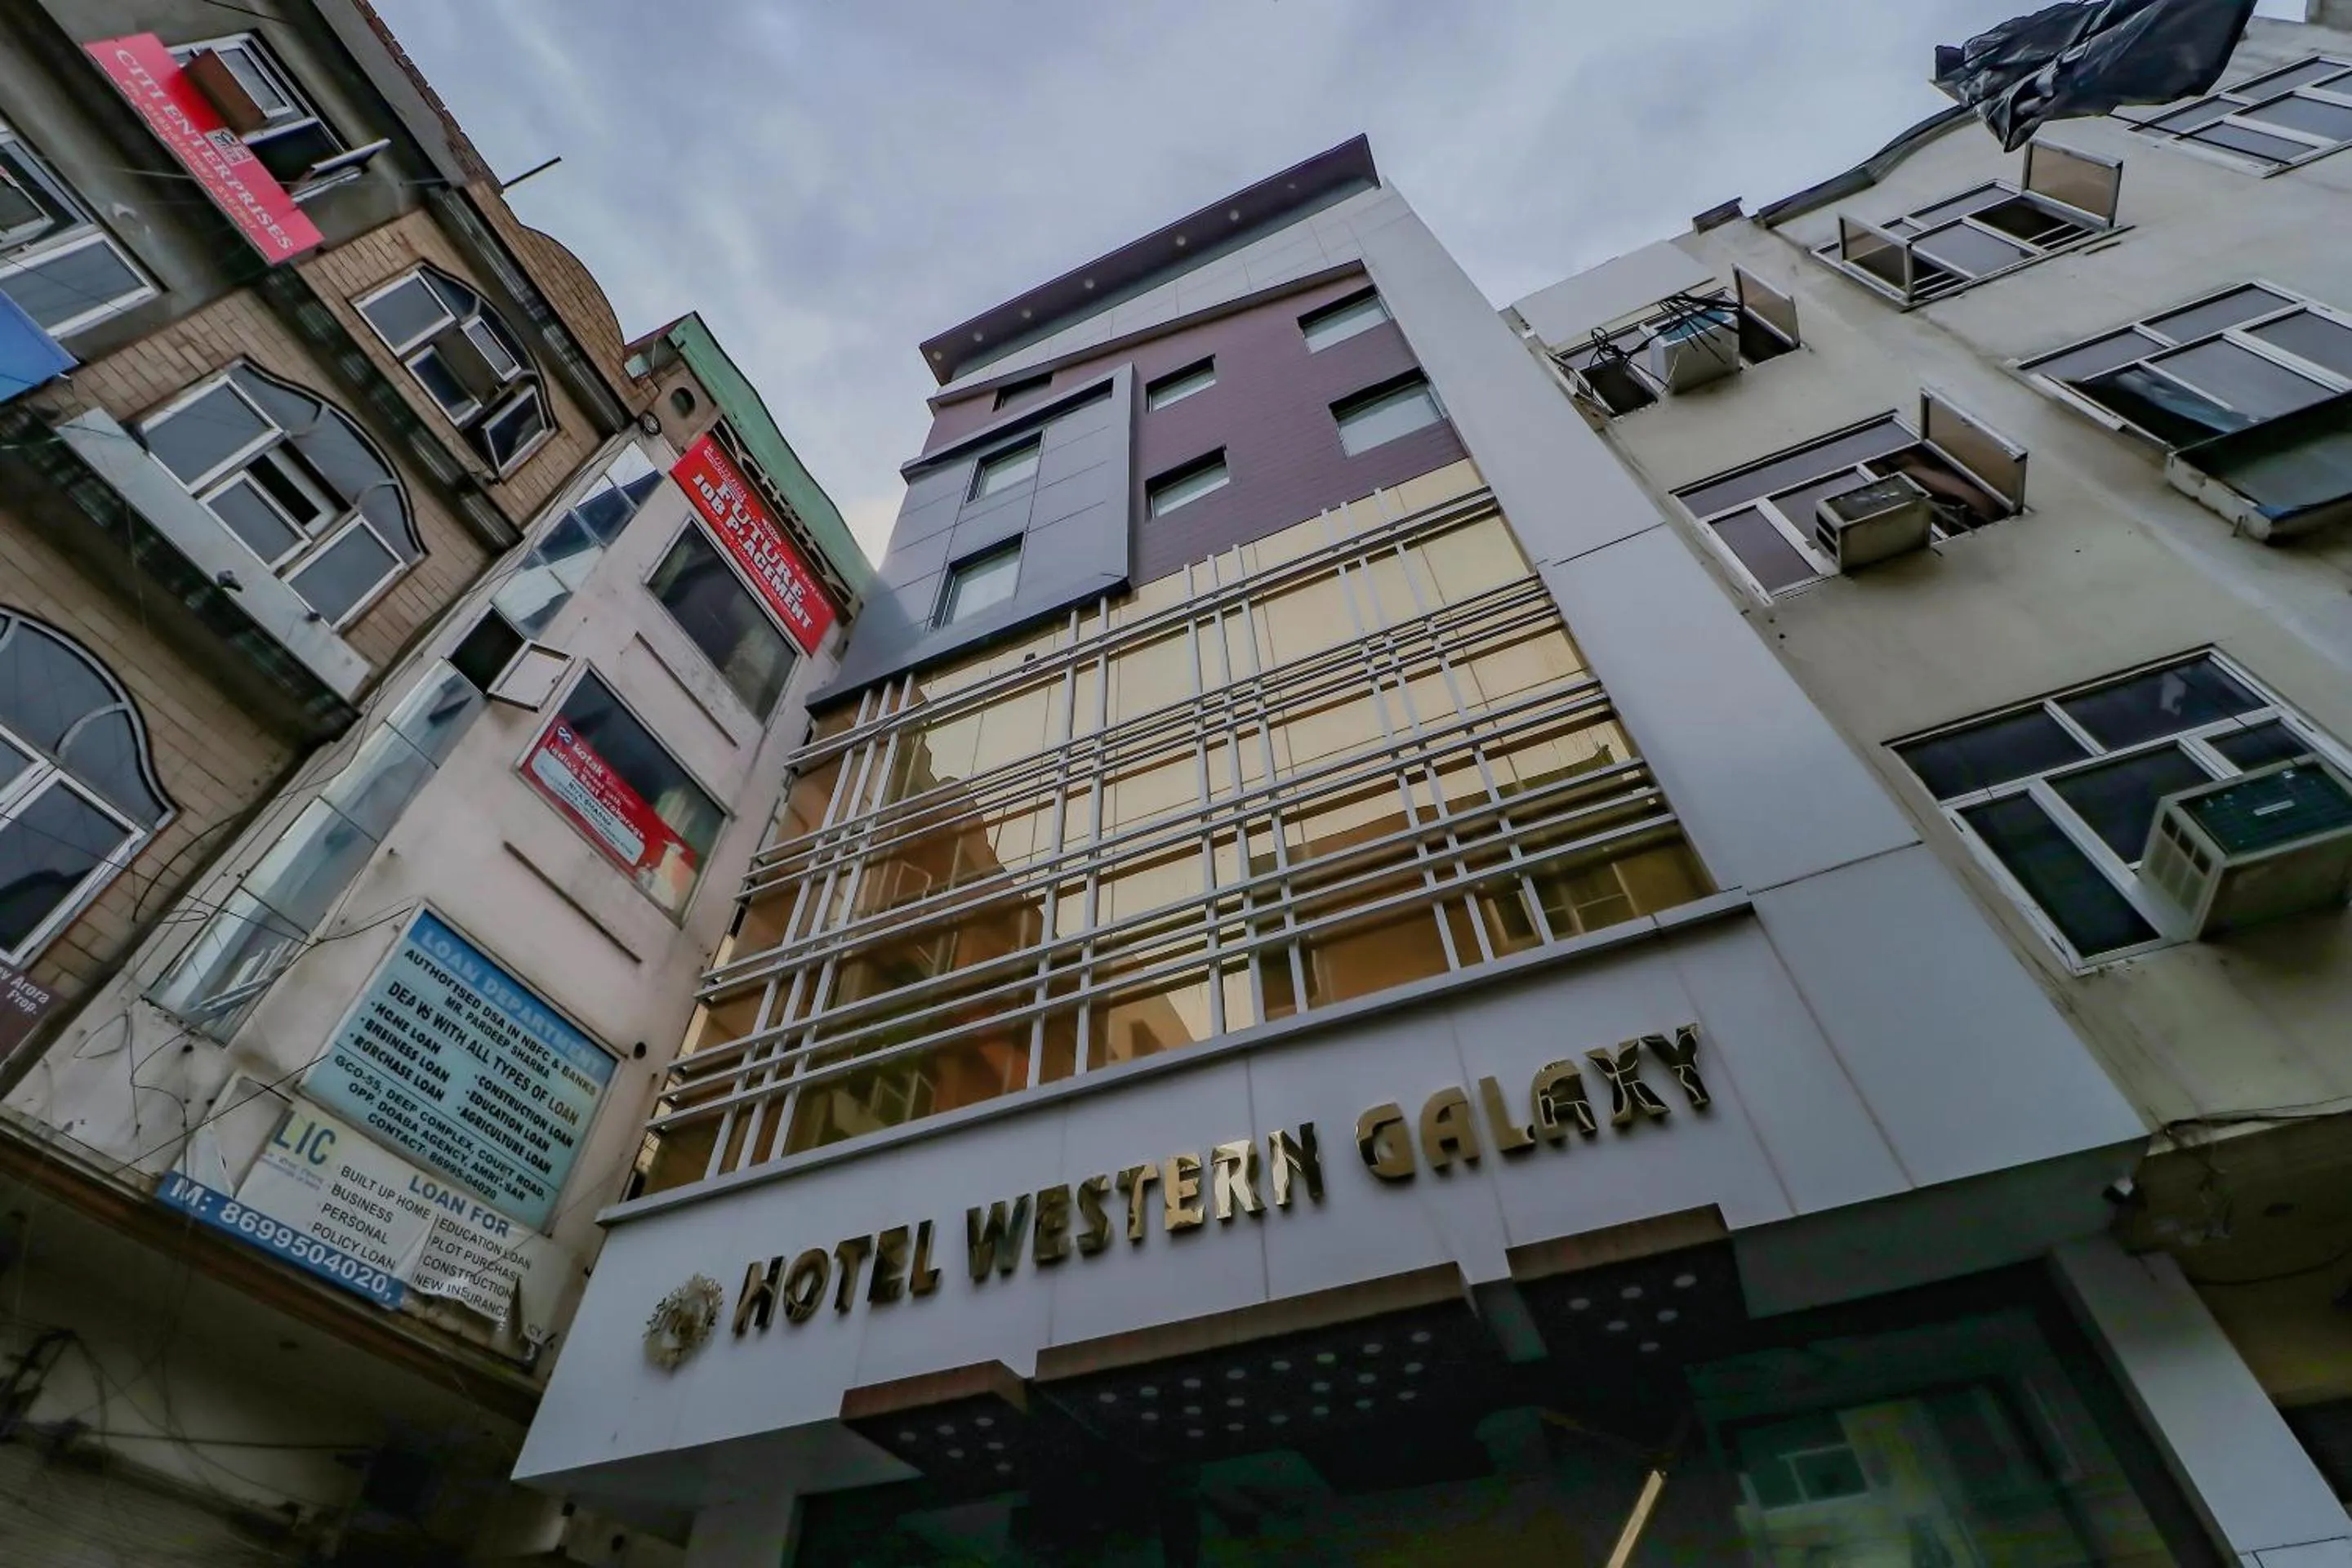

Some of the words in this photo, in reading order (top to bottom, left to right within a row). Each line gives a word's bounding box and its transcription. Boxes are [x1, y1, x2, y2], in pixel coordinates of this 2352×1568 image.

[112, 48, 167, 99] CITI
[160, 103, 294, 250] ENTERPRISES
[692, 471, 727, 516] JOB
[724, 514, 813, 630] PLACEMENT
[715, 481, 808, 603] FUTURE
[571, 741, 605, 777] kotak
[10, 975, 50, 1004] Arora
[419, 928, 482, 983] LOAN
[481, 975, 603, 1077] DEPARTMENT
[408, 1027, 442, 1054] LOAN
[464, 1010, 510, 1050] PARDEEP
[510, 1045, 550, 1080] SHARMA
[481, 1004, 506, 1028] DSA
[506, 1023, 520, 1040] IN
[519, 1034, 550, 1062] NBFC
[550, 1057, 561, 1070] &
[560, 1064, 597, 1097] BANKS
[412, 1074, 445, 1102] LOAN
[417, 1055, 451, 1083] LOAN
[430, 1012, 468, 1046] WITH
[466, 1037, 492, 1064] ALL
[491, 1055, 532, 1092] TYPES
[529, 1083, 548, 1104] OF
[546, 1095, 580, 1126] LOAN
[376, 1100, 420, 1133] DOABA
[384, 1088, 418, 1115] DEEP
[468, 1090, 524, 1134] EDUCATION
[523, 1128, 550, 1152] LOAN
[476, 1074, 548, 1130] CONSTRUCTION
[547, 1124, 574, 1149] LOAN
[272, 1109, 336, 1165] LIC
[458, 1105, 525, 1156] AGRICULTURE
[524, 1150, 552, 1174] LOAN
[170, 1178, 213, 1211] M:
[327, 1183, 395, 1223] BUSINESS
[338, 1165, 378, 1191] BUILT
[376, 1184, 397, 1201] UP
[394, 1194, 432, 1220] HOME
[407, 1174, 466, 1216] LOAN
[469, 1205, 510, 1238] FOR
[734, 1219, 940, 1339] HOTEL
[965, 1121, 1324, 1281] WESTERN
[1354, 1021, 1711, 1182] GALAXY
[308, 1221, 359, 1252] POLICY
[359, 1245, 397, 1272] LOAN
[318, 1202, 391, 1245] PERSONAL
[430, 1236, 462, 1258] PLOT
[438, 1217, 502, 1255] EDUCATION
[503, 1250, 532, 1270] LOAN
[412, 1272, 444, 1292] NEW
[421, 1254, 513, 1300] CONSTRUCTION
